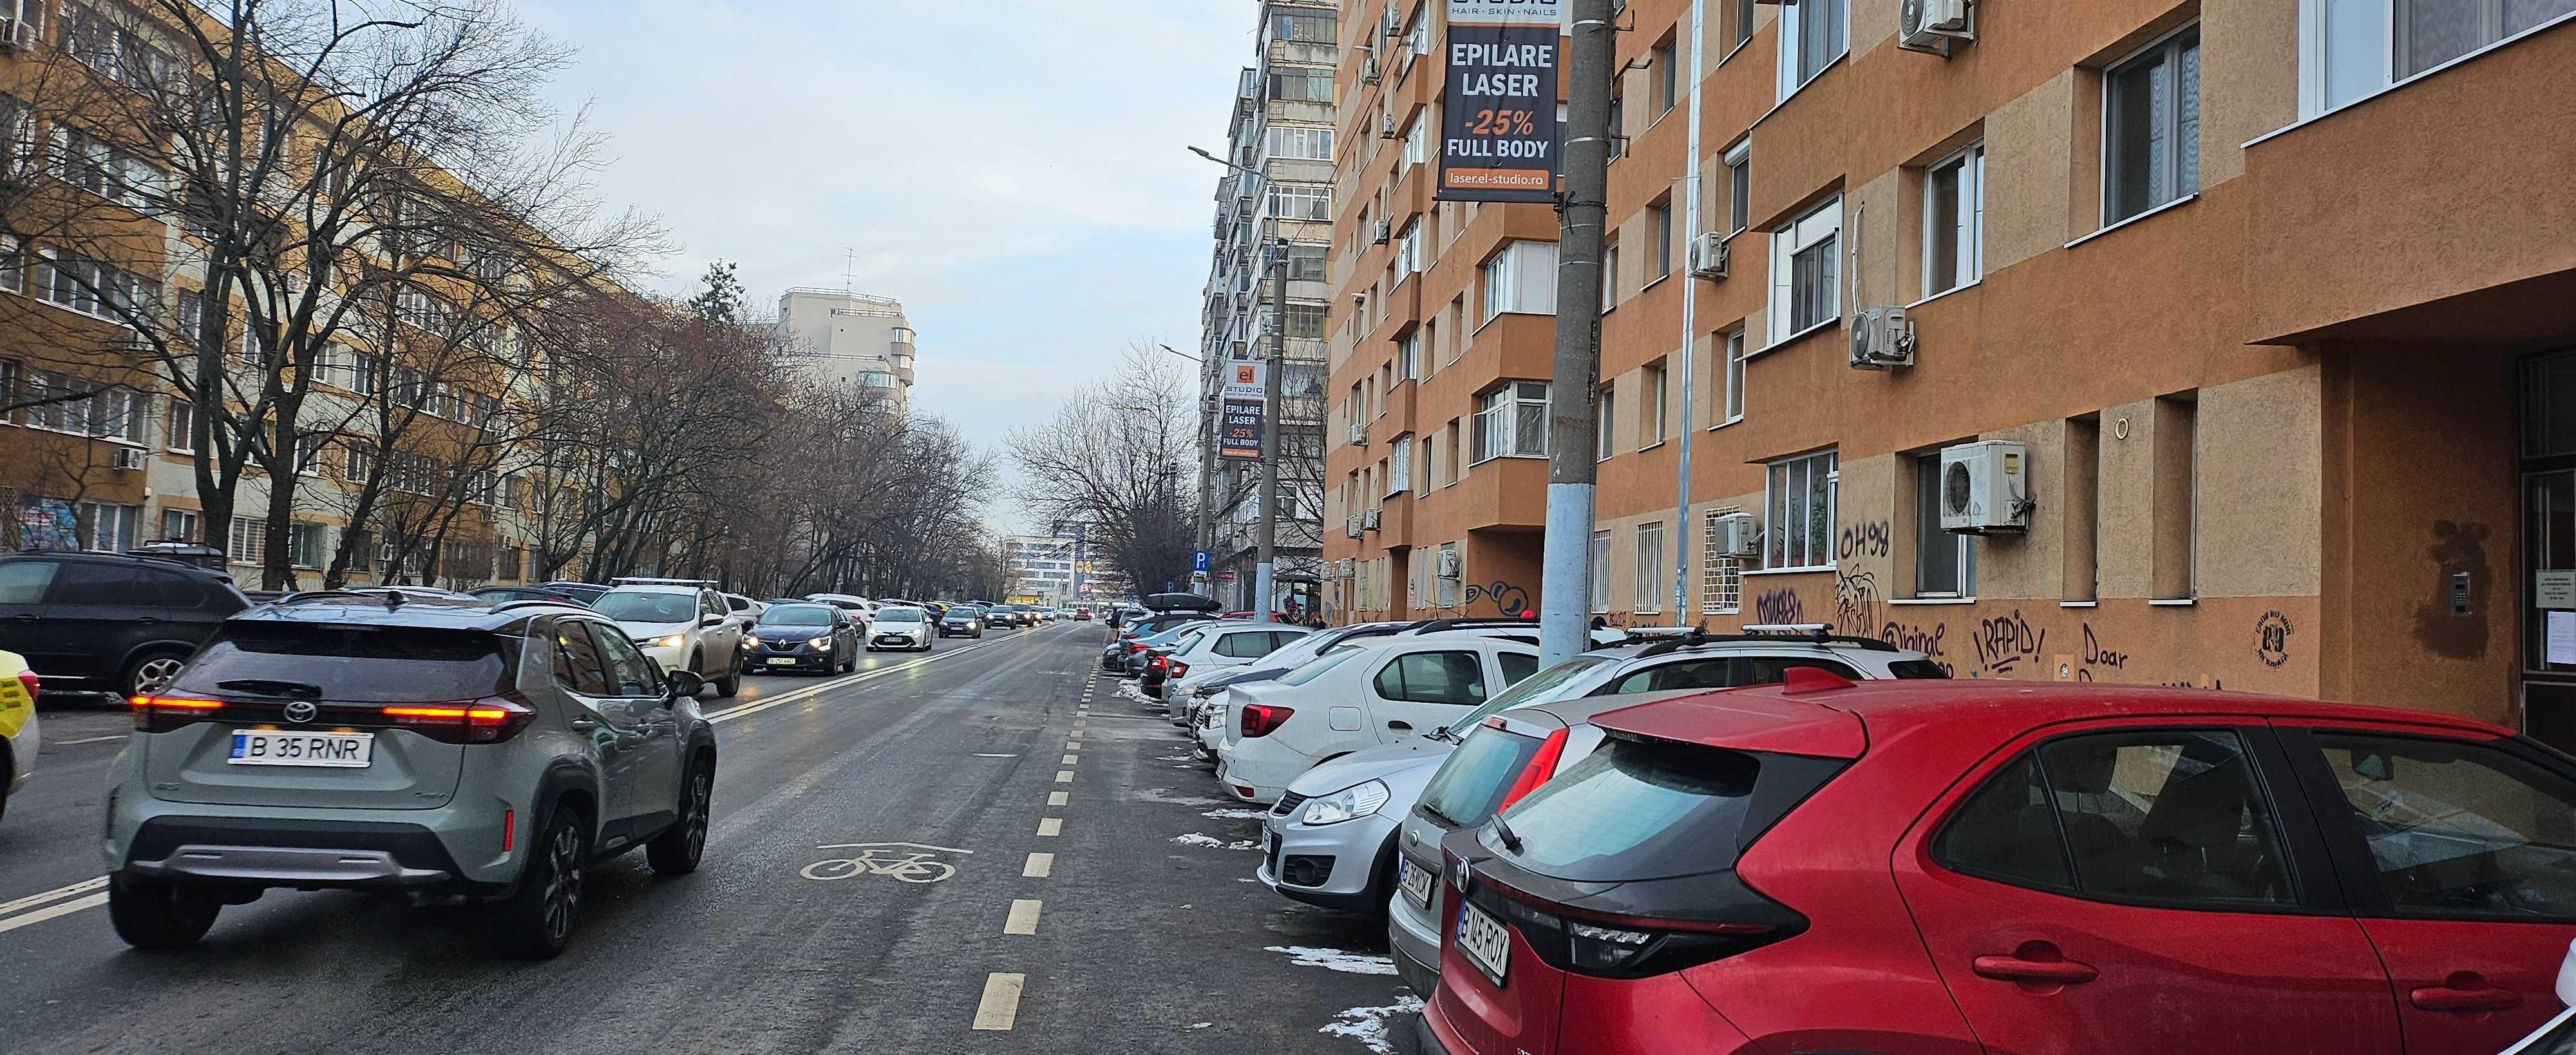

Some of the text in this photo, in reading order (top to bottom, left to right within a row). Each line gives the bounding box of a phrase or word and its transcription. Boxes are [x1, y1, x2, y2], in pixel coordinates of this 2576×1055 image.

[1452, 43, 1553, 68] EPILARE
[1463, 73, 1538, 97] LASER
[1464, 109, 1533, 136] -25%
[1448, 139, 1548, 158] FULL BODY
[1450, 173, 1543, 185] laser.el-studio.ro
[1240, 368, 1253, 381] el
[1226, 404, 1261, 415] EPILARE
[1229, 415, 1256, 425] LASER
[1229, 428, 1253, 438] -25%
[2083, 622, 2128, 669] Doar
[251, 737, 359, 759] B 35 RNR
[1403, 861, 1409, 882] B
[1461, 905, 1507, 971] B 145 ROX
